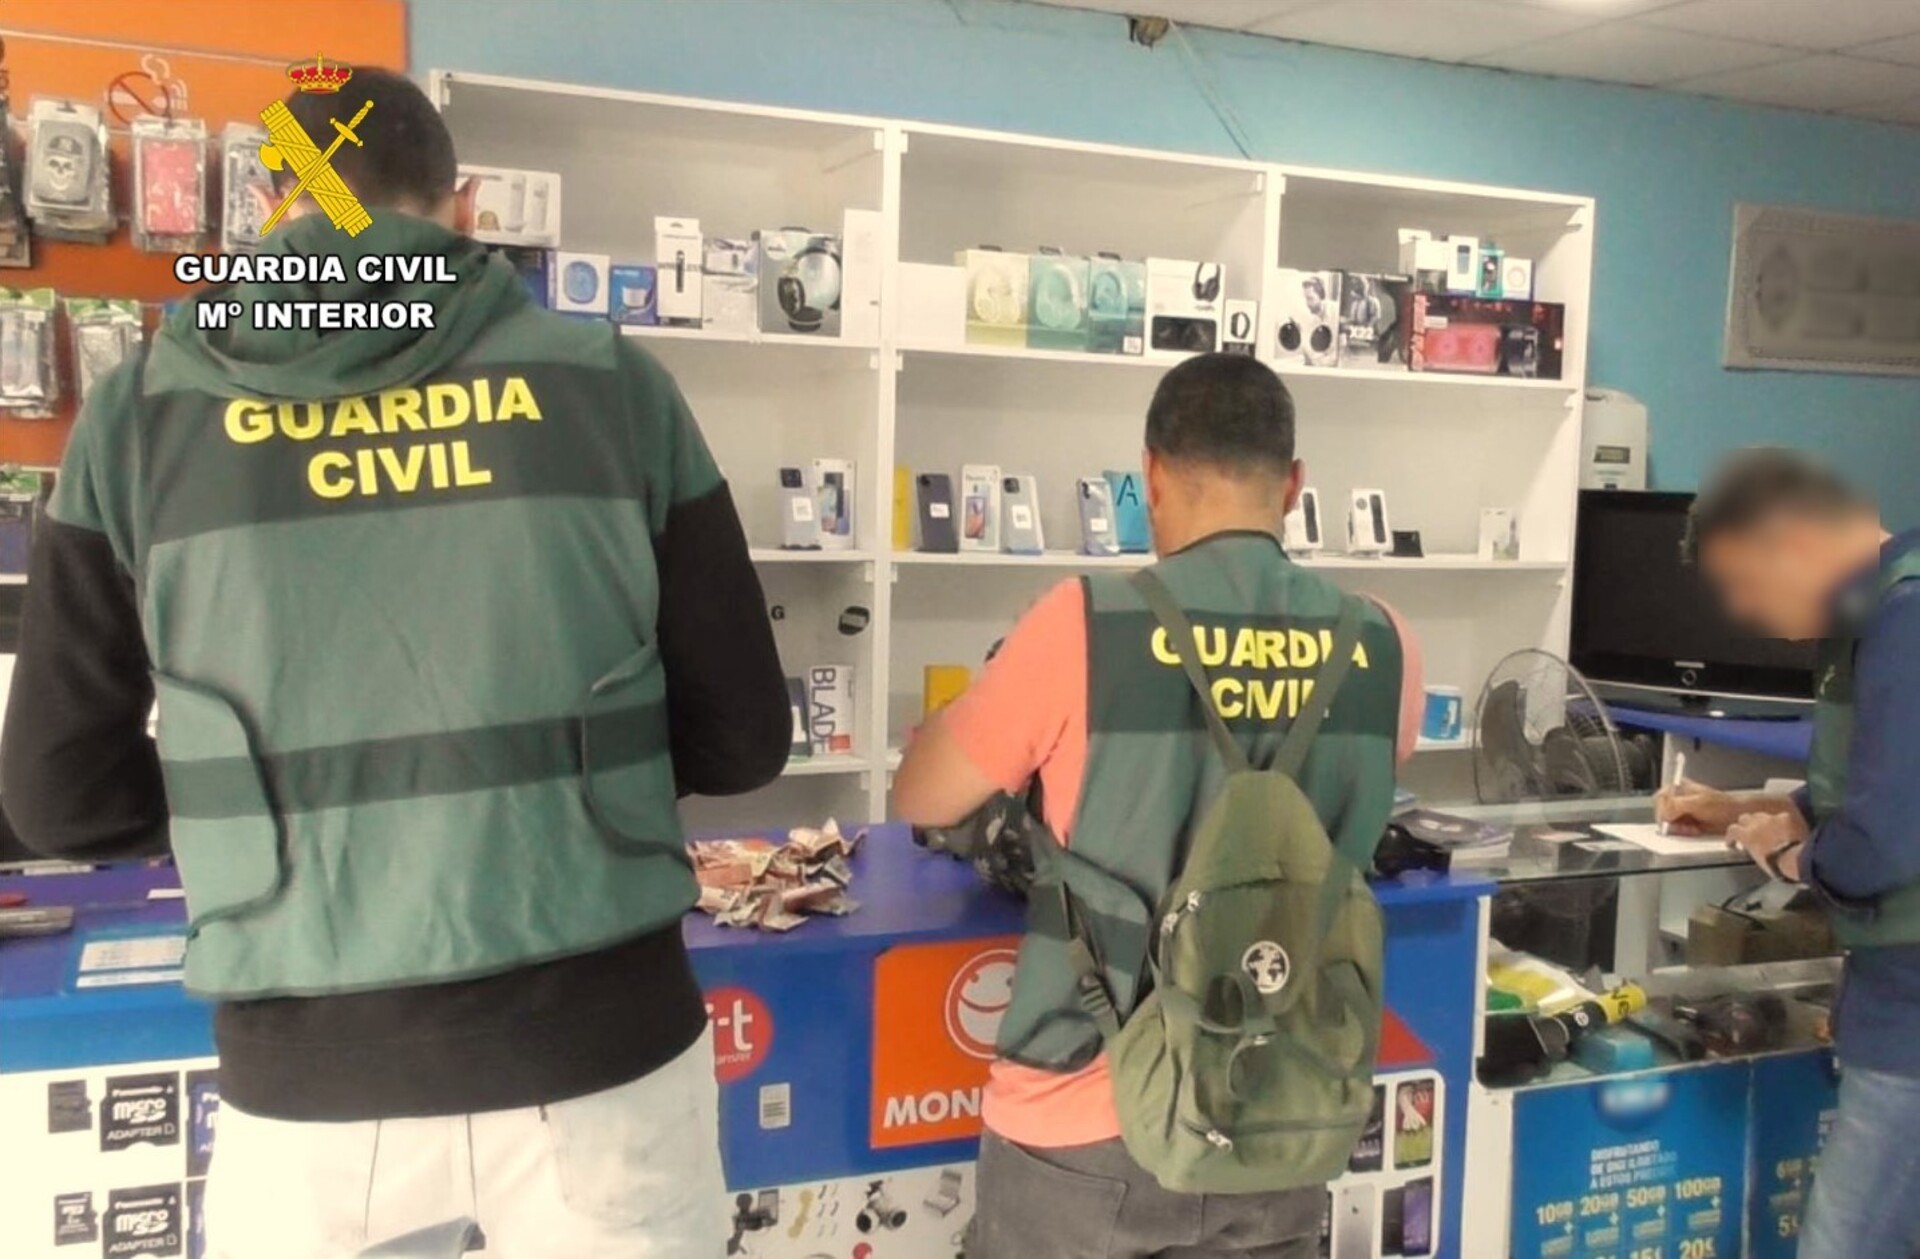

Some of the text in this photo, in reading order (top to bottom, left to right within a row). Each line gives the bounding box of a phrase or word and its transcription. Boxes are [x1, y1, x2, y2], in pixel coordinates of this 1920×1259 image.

[224, 376, 543, 444] GUARDIA
[307, 440, 492, 499] CIVIL
[106, 1124, 162, 1141] ADAPTER
[108, 1238, 165, 1254] ADAPTER
